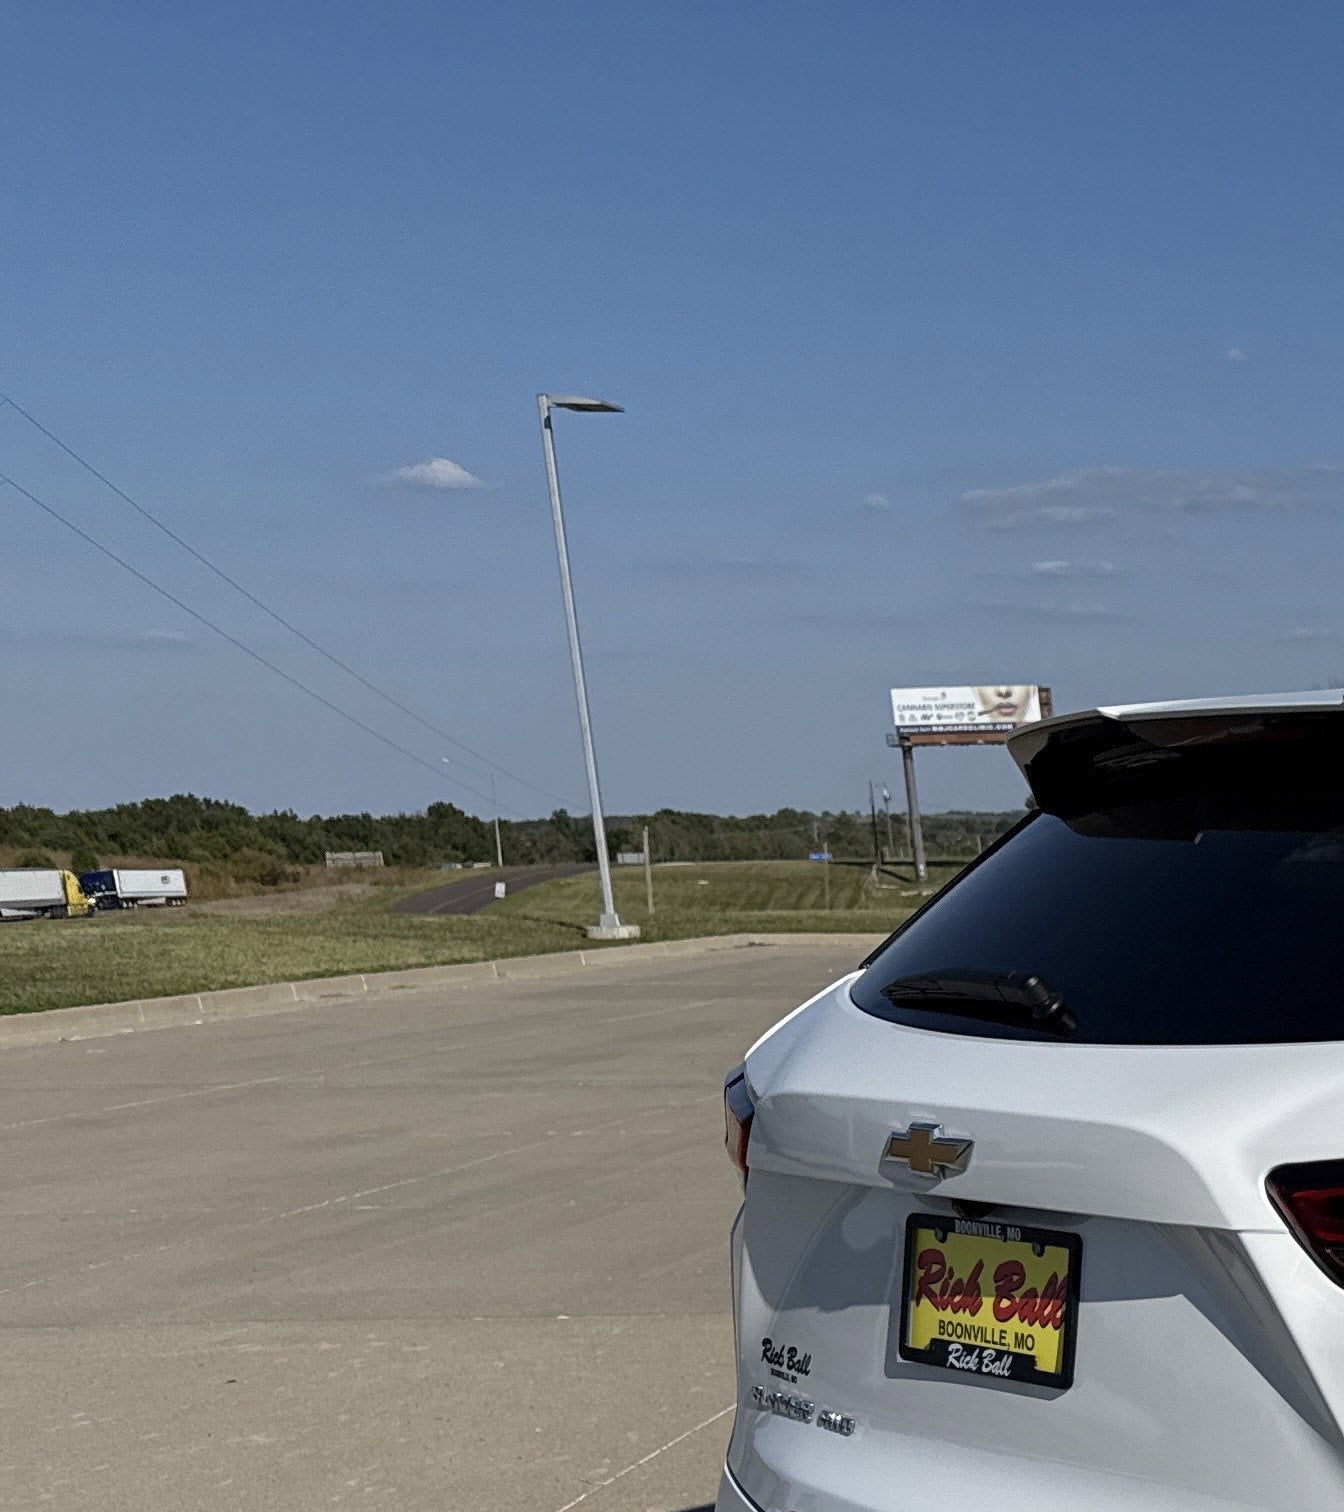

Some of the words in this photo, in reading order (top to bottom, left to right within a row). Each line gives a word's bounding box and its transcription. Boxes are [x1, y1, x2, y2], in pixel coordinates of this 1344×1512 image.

[954, 1219, 1005, 1241] BOONVILLE,
[1006, 1227, 1021, 1241] MO
[915, 1248, 985, 1317] Rick
[993, 1259, 1069, 1331] Ball
[938, 1319, 1011, 1350] BOONVILLE,
[1014, 1331, 1036, 1351] MO
[786, 1346, 812, 1377] Ball
[945, 1343, 980, 1371] Rick
[981, 1348, 1013, 1377] Ball
